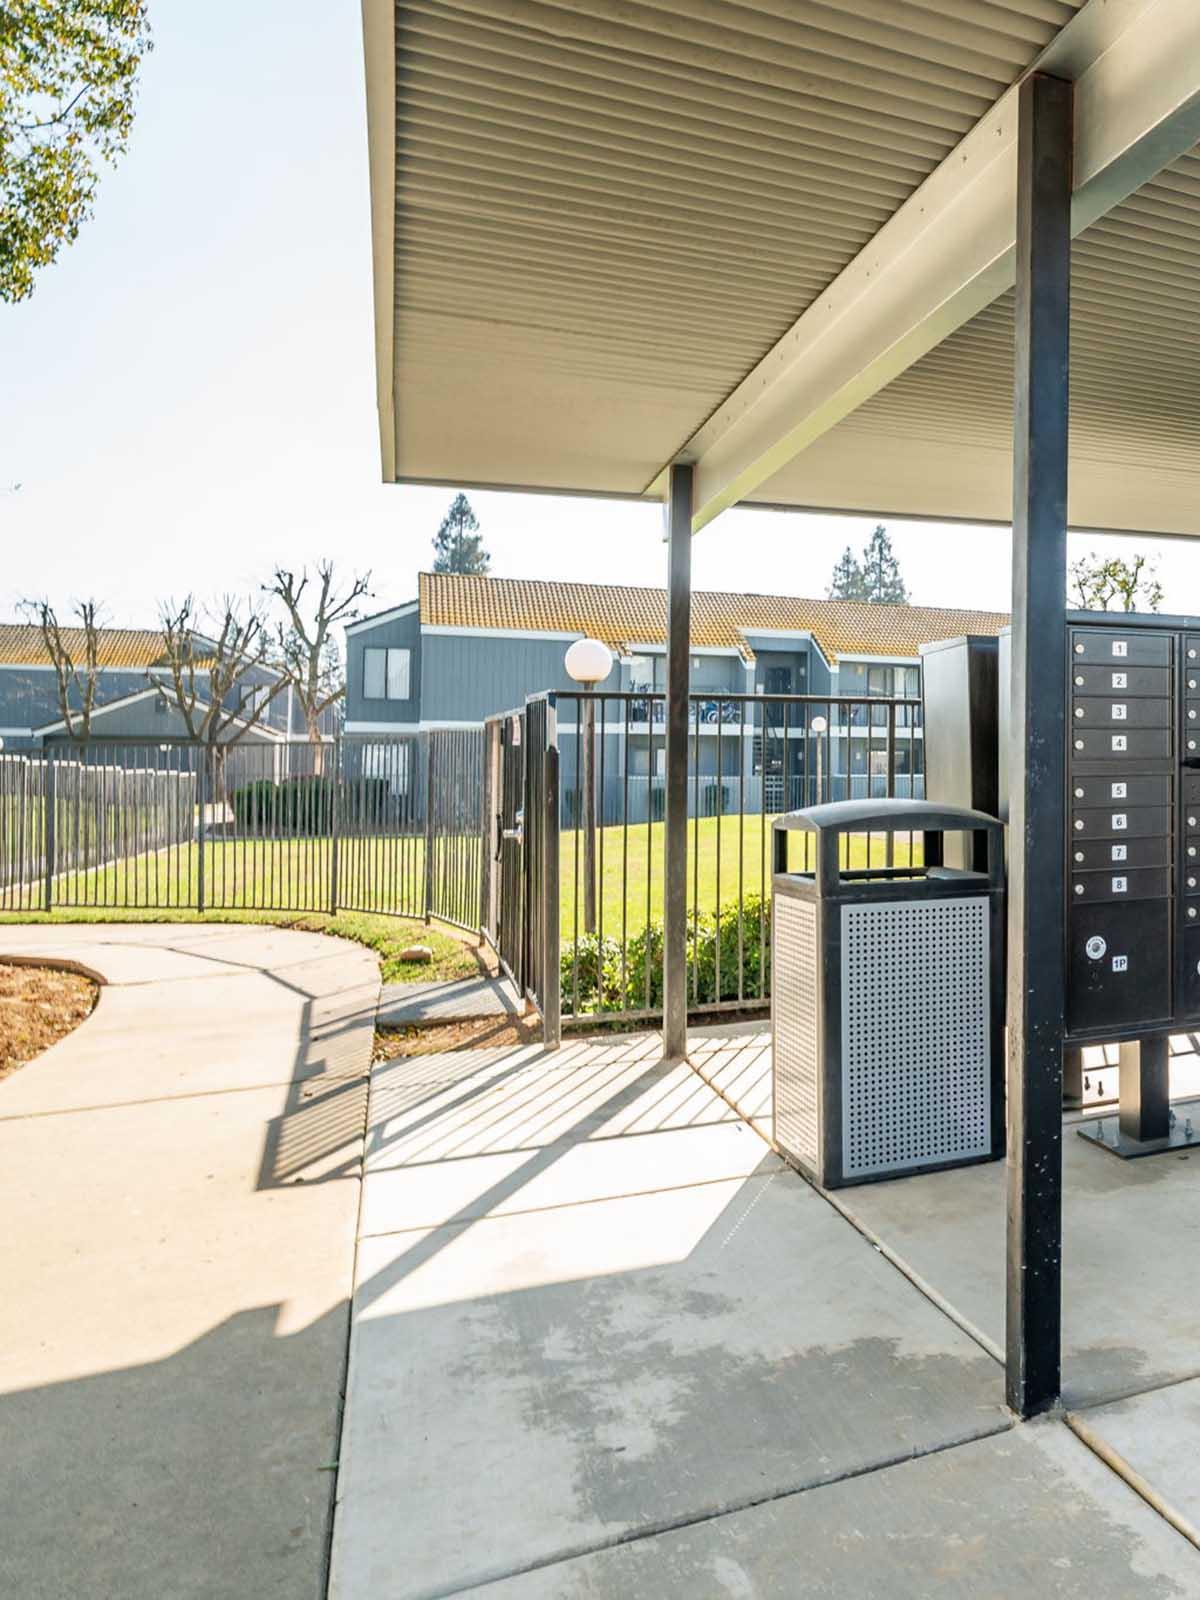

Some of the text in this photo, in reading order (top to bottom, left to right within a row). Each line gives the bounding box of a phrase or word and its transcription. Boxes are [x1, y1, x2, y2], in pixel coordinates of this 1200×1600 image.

[1116, 675, 1123, 686] 2
[1116, 706, 1123, 717] 3
[1116, 738, 1122, 748] 4
[1116, 785, 1123, 796] 5
[1116, 816, 1123, 827] 6
[1116, 847, 1122, 858] 7
[1116, 879, 1123, 890] 8
[1114, 958, 1126, 969] 1P
